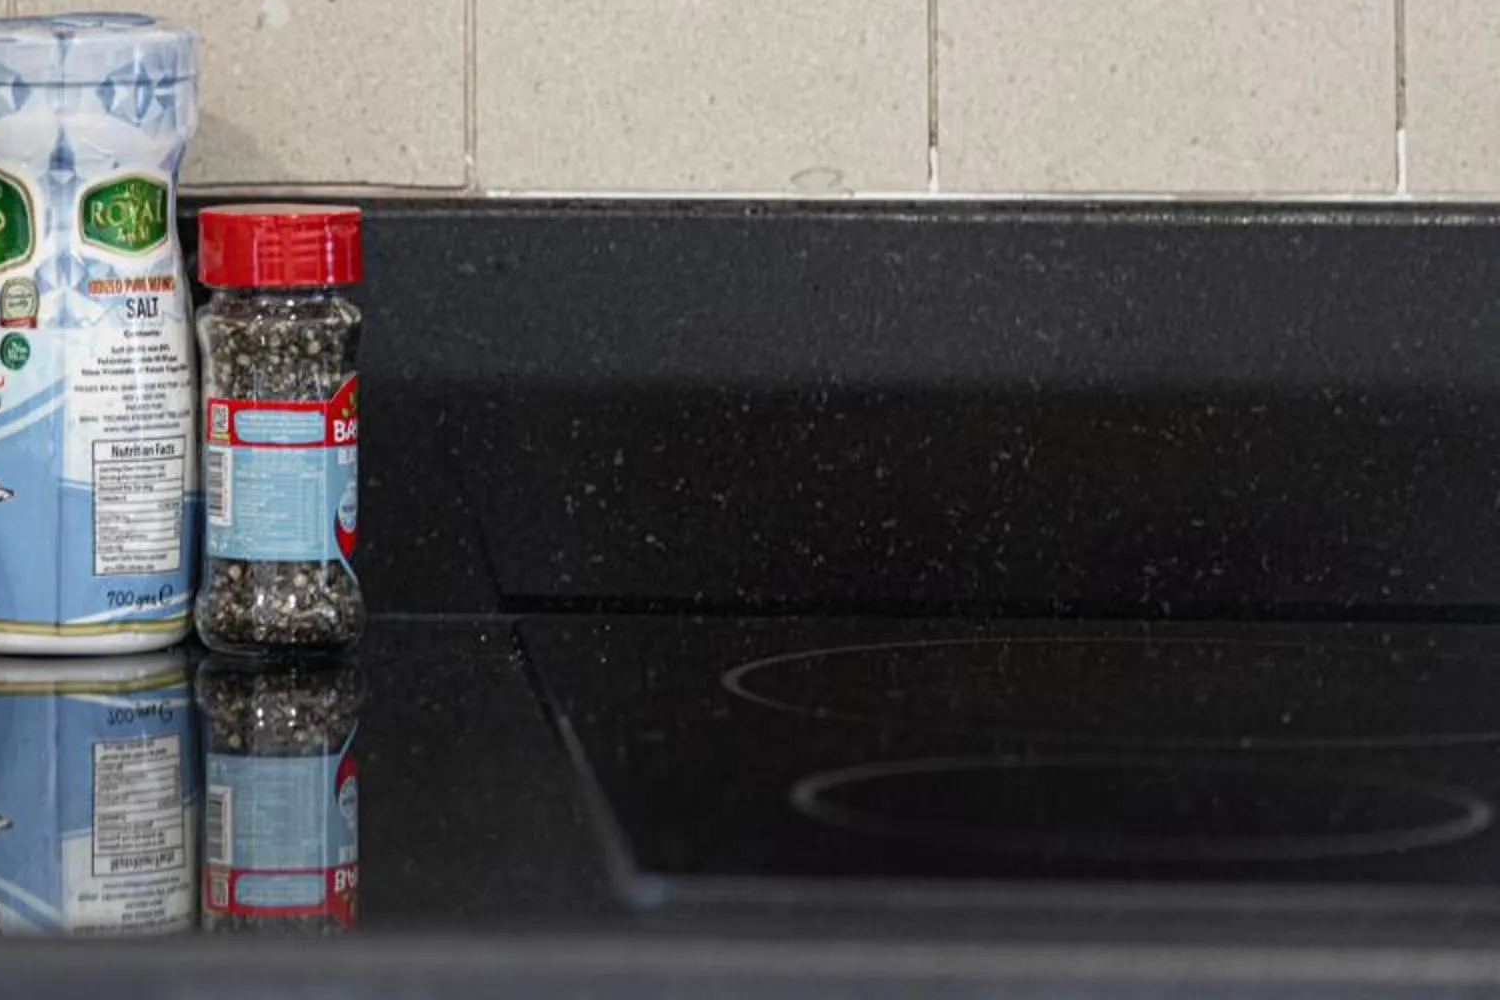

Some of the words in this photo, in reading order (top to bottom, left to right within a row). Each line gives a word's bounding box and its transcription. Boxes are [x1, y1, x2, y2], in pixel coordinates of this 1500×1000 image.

[91, 189, 163, 226] ROYAL
[125, 296, 159, 318] SALT
[106, 588, 135, 607] 700
